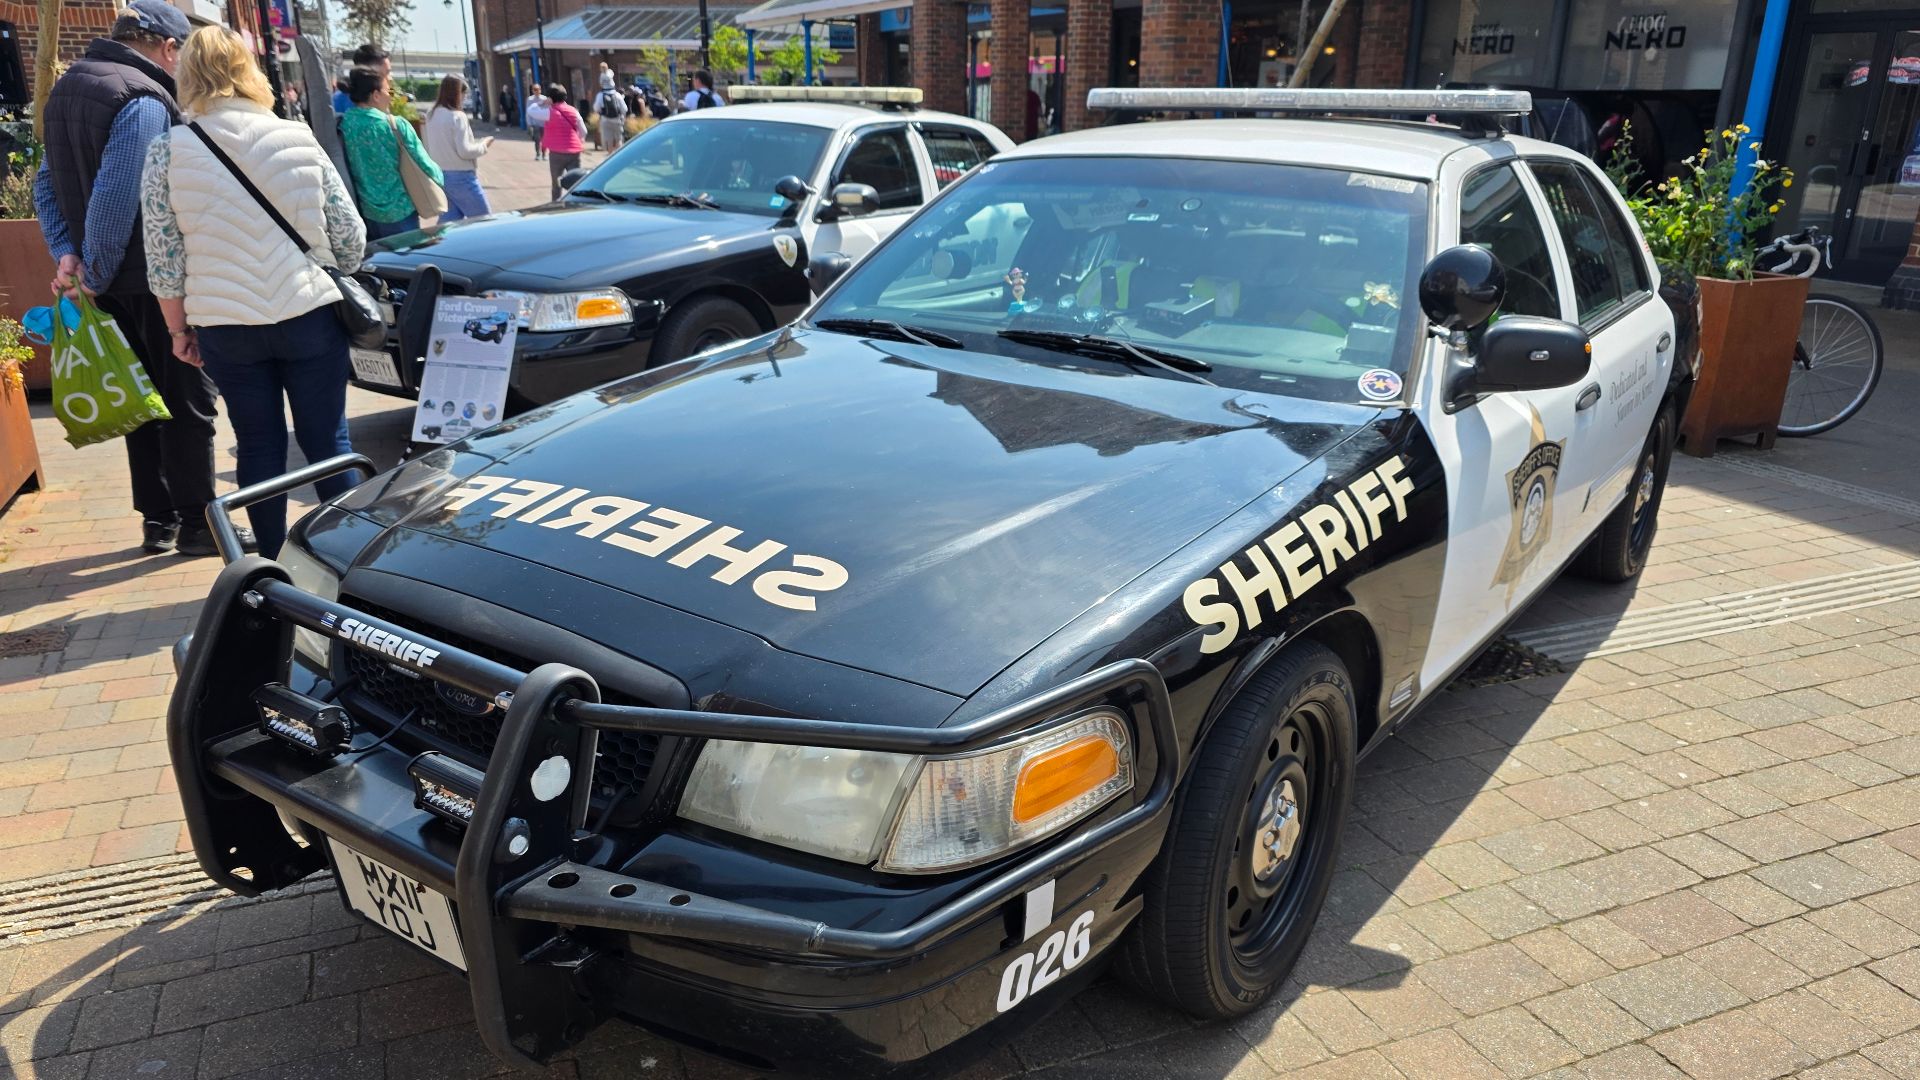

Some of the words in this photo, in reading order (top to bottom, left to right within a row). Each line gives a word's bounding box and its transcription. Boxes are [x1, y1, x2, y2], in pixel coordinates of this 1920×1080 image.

[1452, 34, 1514, 56] NERO
[1604, 26, 1686, 51] NERO
[438, 300, 462, 311] Ford
[464, 302, 498, 313] Crown
[62, 361, 153, 424] OSE
[1513, 450, 1541, 492] SHERIFF'S
[1541, 444, 1560, 467] OFFICE
[1183, 455, 1415, 653] SHERIFF
[338, 618, 441, 668] SHERIFF
[367, 889, 437, 950] YOJ
[997, 910, 1095, 1012] 026
